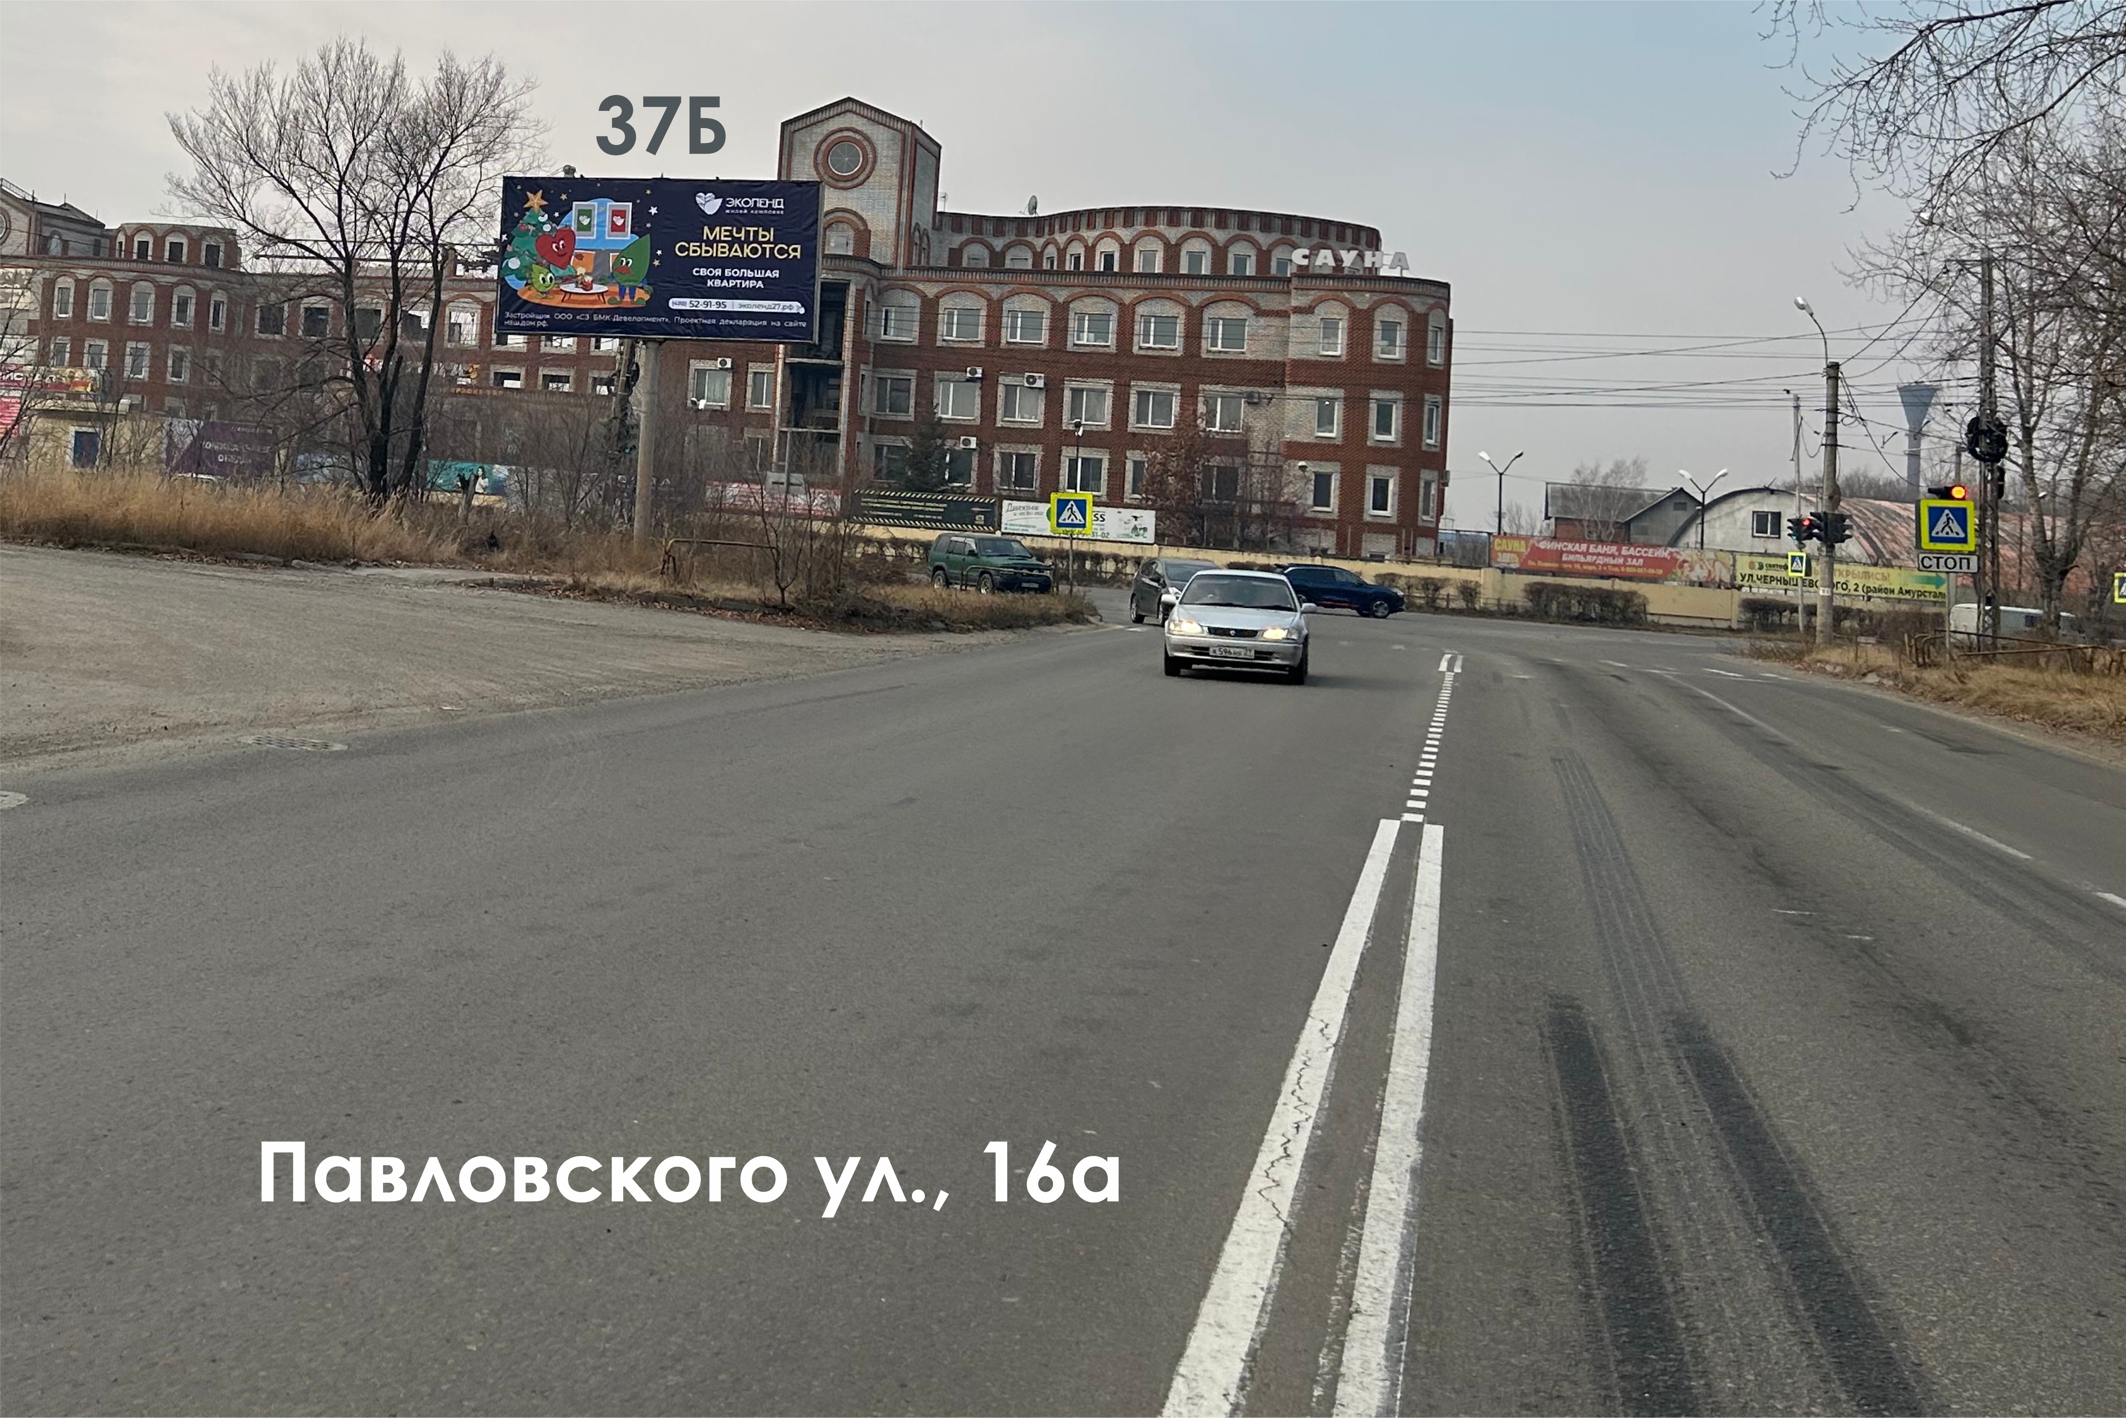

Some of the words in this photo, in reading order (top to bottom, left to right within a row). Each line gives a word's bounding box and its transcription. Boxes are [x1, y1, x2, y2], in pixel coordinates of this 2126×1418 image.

[726, 197, 785, 209] ЭКОЛЕНД
[703, 226, 774, 242] МЕЧТЫ
[675, 241, 801, 260] СБЫВАЮТСЯ
[1291, 248, 1409, 271] САУНА
[692, 267, 722, 277] СВОЯ
[724, 268, 780, 279] БОЛЬШАЯ
[707, 279, 765, 289] КВАРТИРА
[689, 300, 728, 309] 52-91-95
[673, 316, 716, 326] Проектная
[719, 318, 768, 327] декларация
[784, 320, 807, 328] сайте
[1494, 538, 1526, 552] САУНА
[1538, 541, 1587, 552] ФИНСКАЯ
[1588, 544, 1619, 556] БАНЯ,
[1621, 546, 1671, 560] БАССЕЙН,
[1562, 553, 1624, 565] БИЛЬЯРДНЫЙ
[1625, 556, 1644, 566] ЗАЛ
[1920, 555, 1971, 571] СТОП
[1834, 568, 1891, 582] ТКРЫЛИСЬ!
[1853, 584, 1860, 592] 2
[1861, 584, 1895, 596] (район
